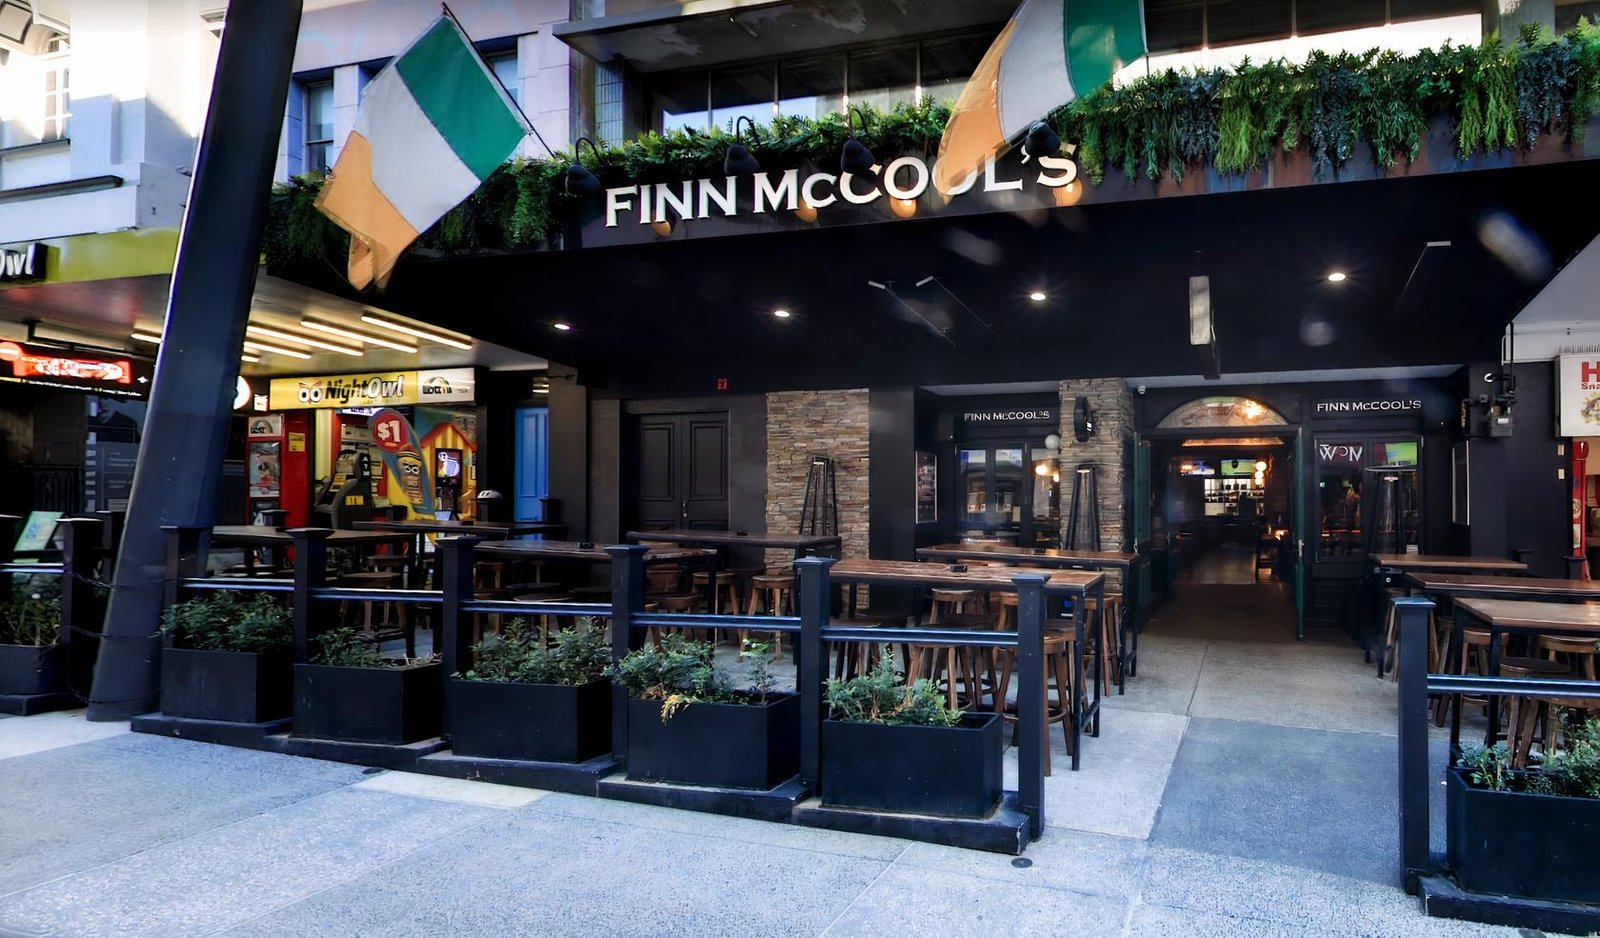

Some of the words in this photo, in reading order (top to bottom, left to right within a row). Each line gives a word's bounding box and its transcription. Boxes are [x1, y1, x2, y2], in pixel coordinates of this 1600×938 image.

[605, 175, 738, 228] FINN
[325, 374, 404, 404] NightOwl
[964, 412, 991, 421] FINN
[993, 410, 1050, 420] McCOOL'S
[1317, 402, 1349, 412] FINN
[1352, 400, 1422, 411] McCOOL'S
[377, 420, 400, 442] $1
